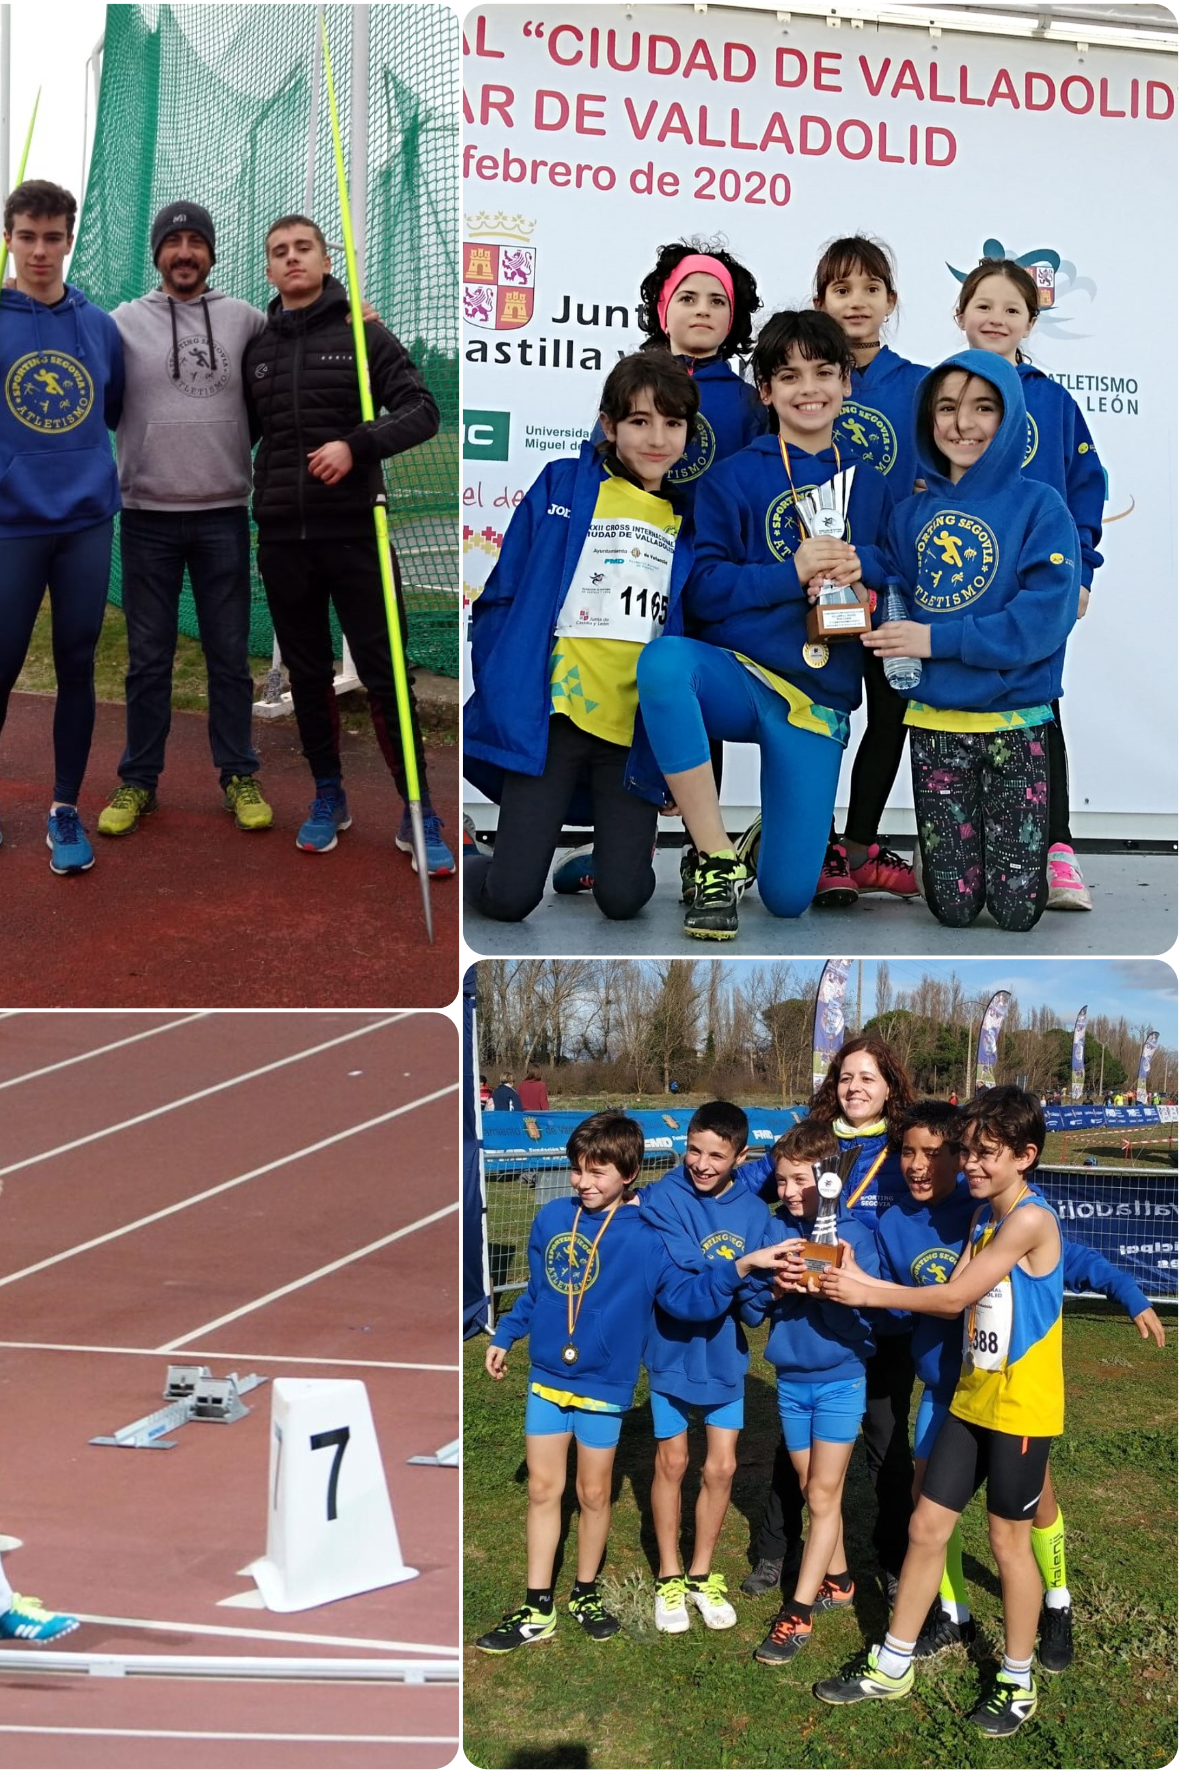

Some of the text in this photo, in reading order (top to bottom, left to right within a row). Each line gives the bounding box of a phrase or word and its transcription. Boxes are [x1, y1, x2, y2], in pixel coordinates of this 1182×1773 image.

[463, 15, 505, 59] L
[522, 20, 757, 83] “CIUDAD
[775, 47, 843, 93] DE
[534, 89, 607, 136] DE
[623, 97, 957, 167] VALLADOLID
[463, 144, 791, 206] febrero de 2020
[551, 295, 651, 332] Junt
[50, 356, 85, 388] SEGOVIA
[17, 397, 88, 428] ATLETISMO
[1086, 394, 1139, 415] LEÓN
[463, 424, 494, 445] C
[525, 425, 589, 439] Universida
[858, 408, 890, 444] SEGOVIA
[525, 438, 565, 451] Miguel
[632, 525, 675, 547] INTERNACIONAL
[958, 517, 993, 564] SEGOVIA
[620, 585, 669, 625] 1165
[915, 575, 986, 608] TLETISMO
[752, 1129, 774, 1140] FMD
[310, 1425, 350, 1521] 7
